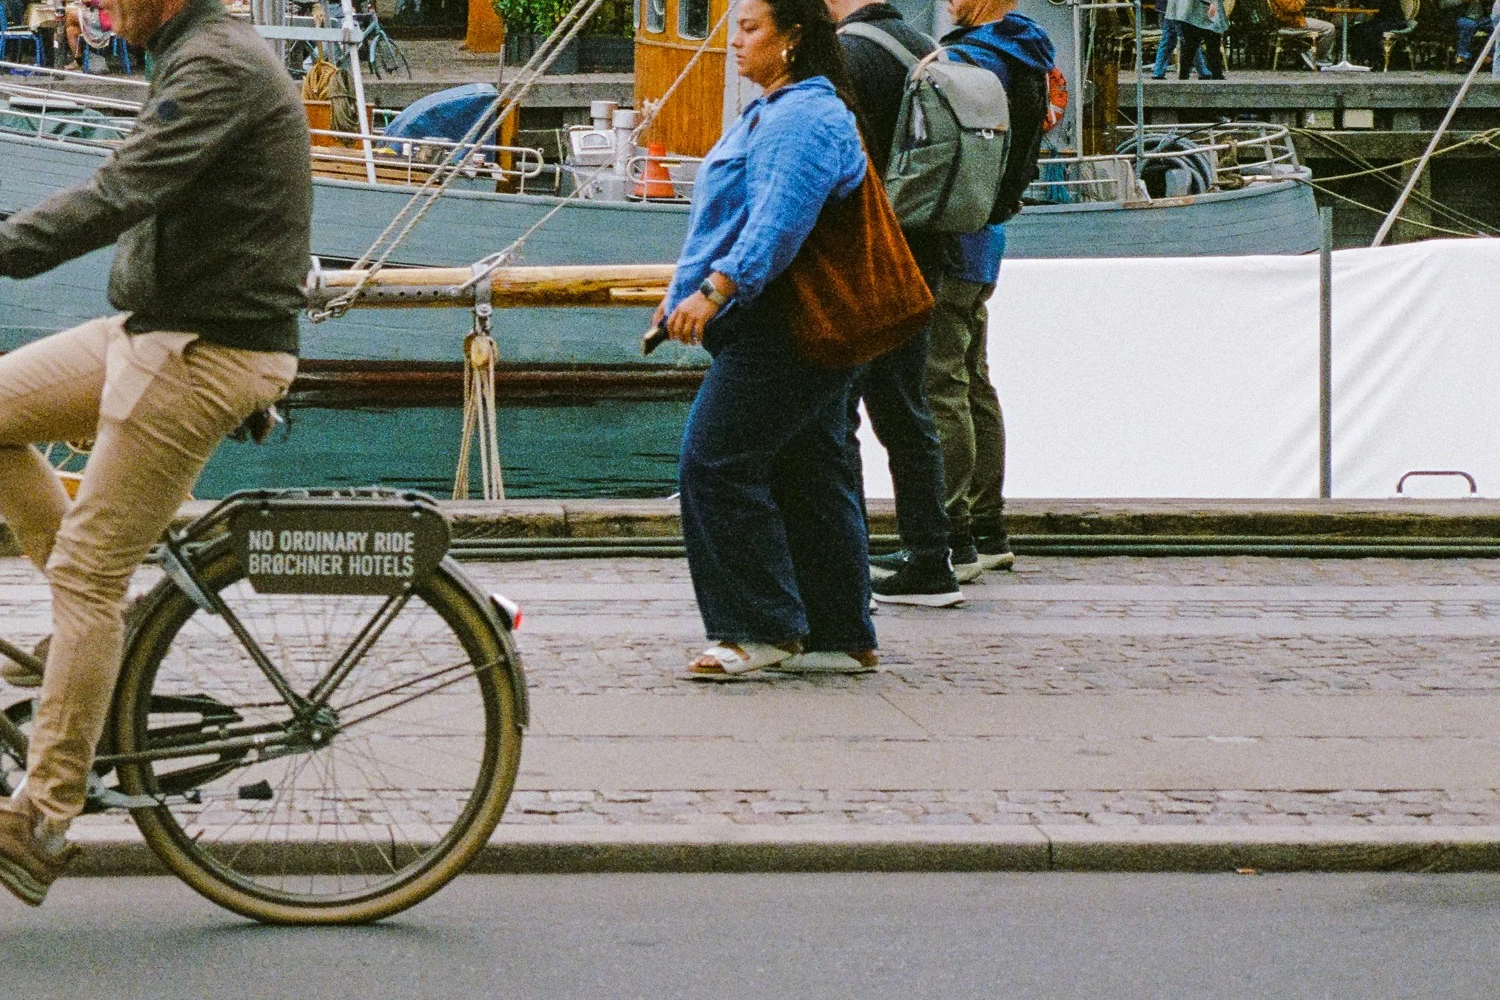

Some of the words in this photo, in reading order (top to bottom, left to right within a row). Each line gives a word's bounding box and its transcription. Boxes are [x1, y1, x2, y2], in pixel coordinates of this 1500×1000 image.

[249, 530, 274, 550] NO
[279, 530, 368, 552] ORDINARY
[374, 531, 415, 553] RIDE
[249, 553, 343, 576] BRØCHNER
[349, 555, 415, 577] HOTELS
